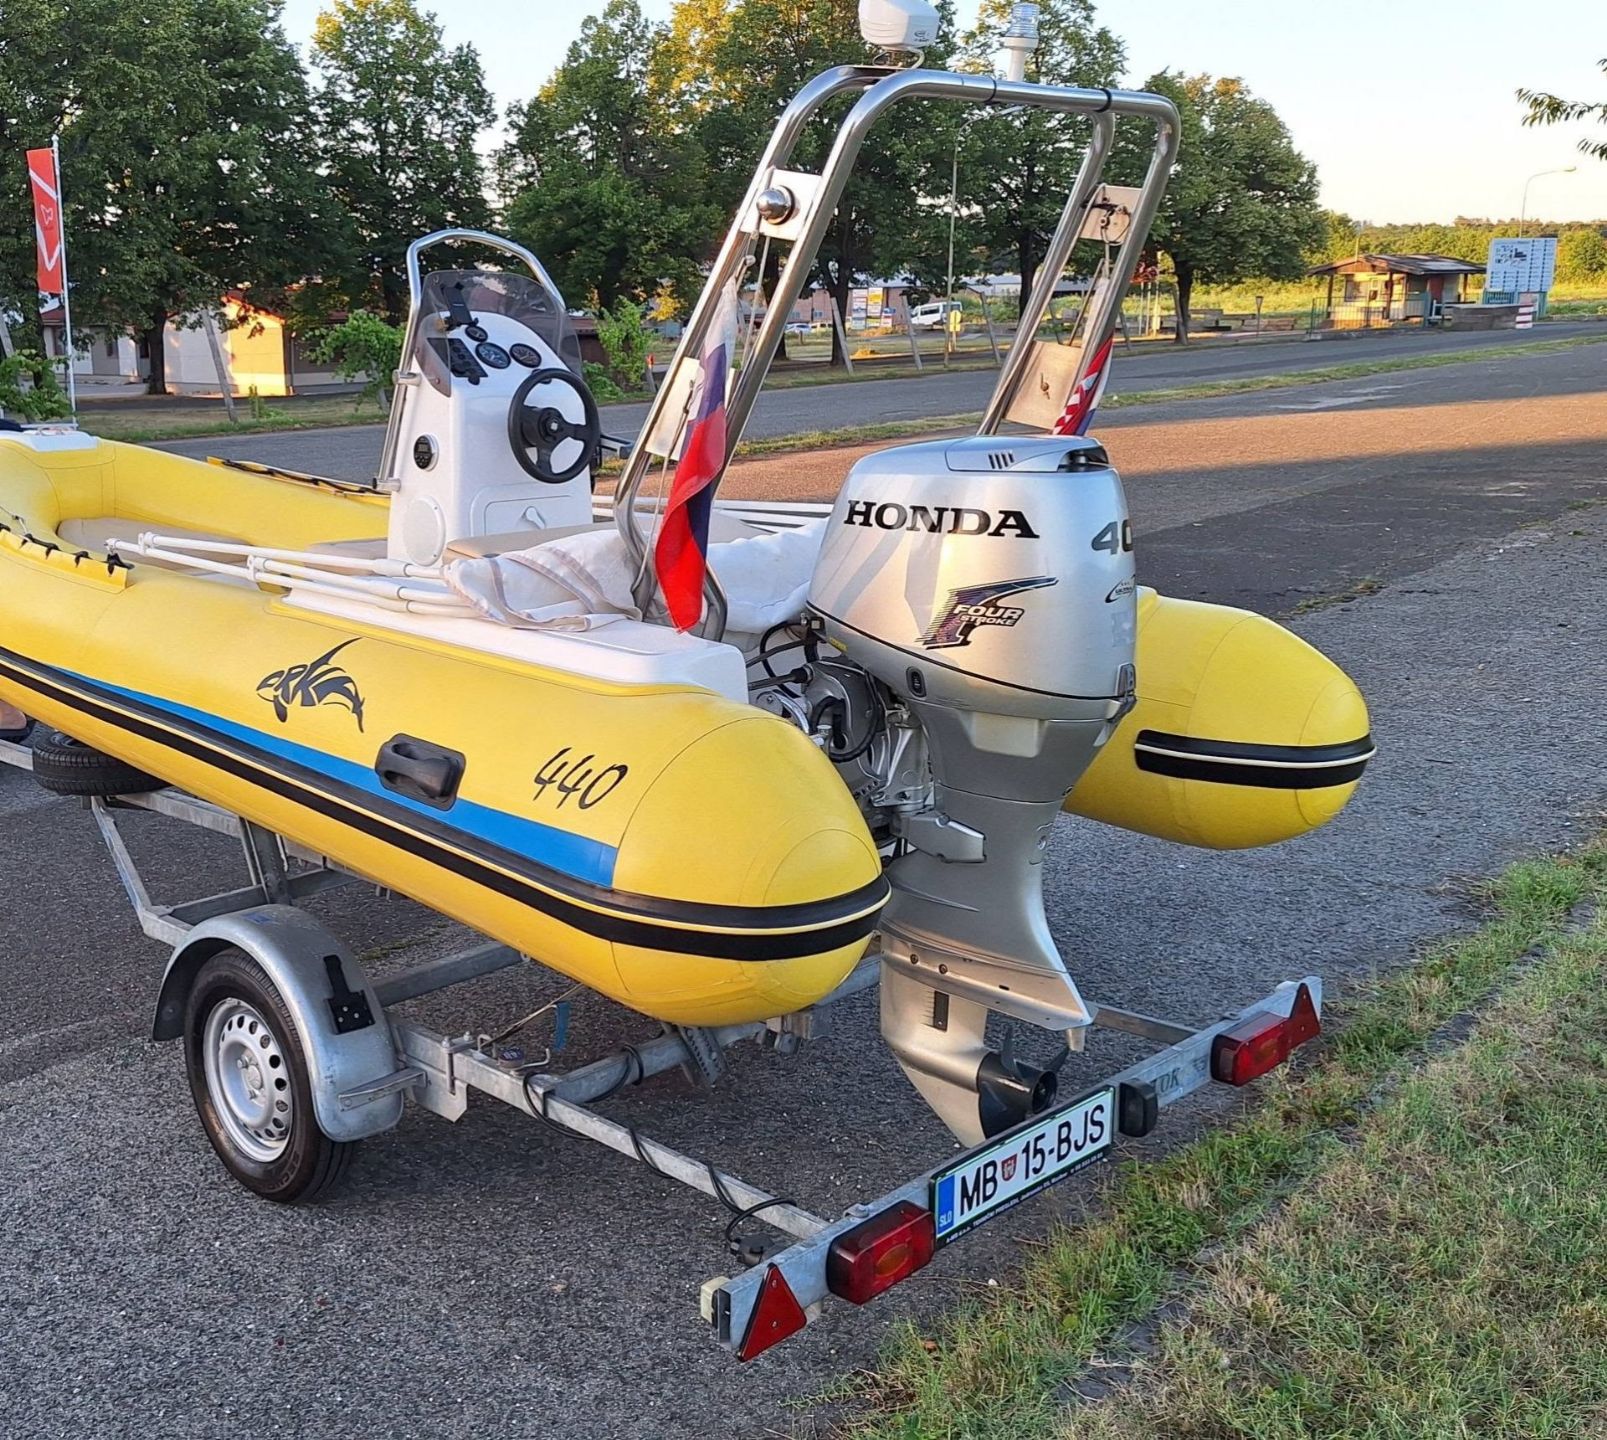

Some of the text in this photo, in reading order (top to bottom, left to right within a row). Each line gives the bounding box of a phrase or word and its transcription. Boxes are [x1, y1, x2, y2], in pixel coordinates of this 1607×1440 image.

[843, 499, 1040, 539] HONDA
[953, 604, 1023, 619] FOUR
[960, 615, 1016, 626] STROKE
[532, 746, 629, 810] 440
[960, 1103, 1105, 1217] MB 15-BJS
[939, 1210, 953, 1227] SLO
